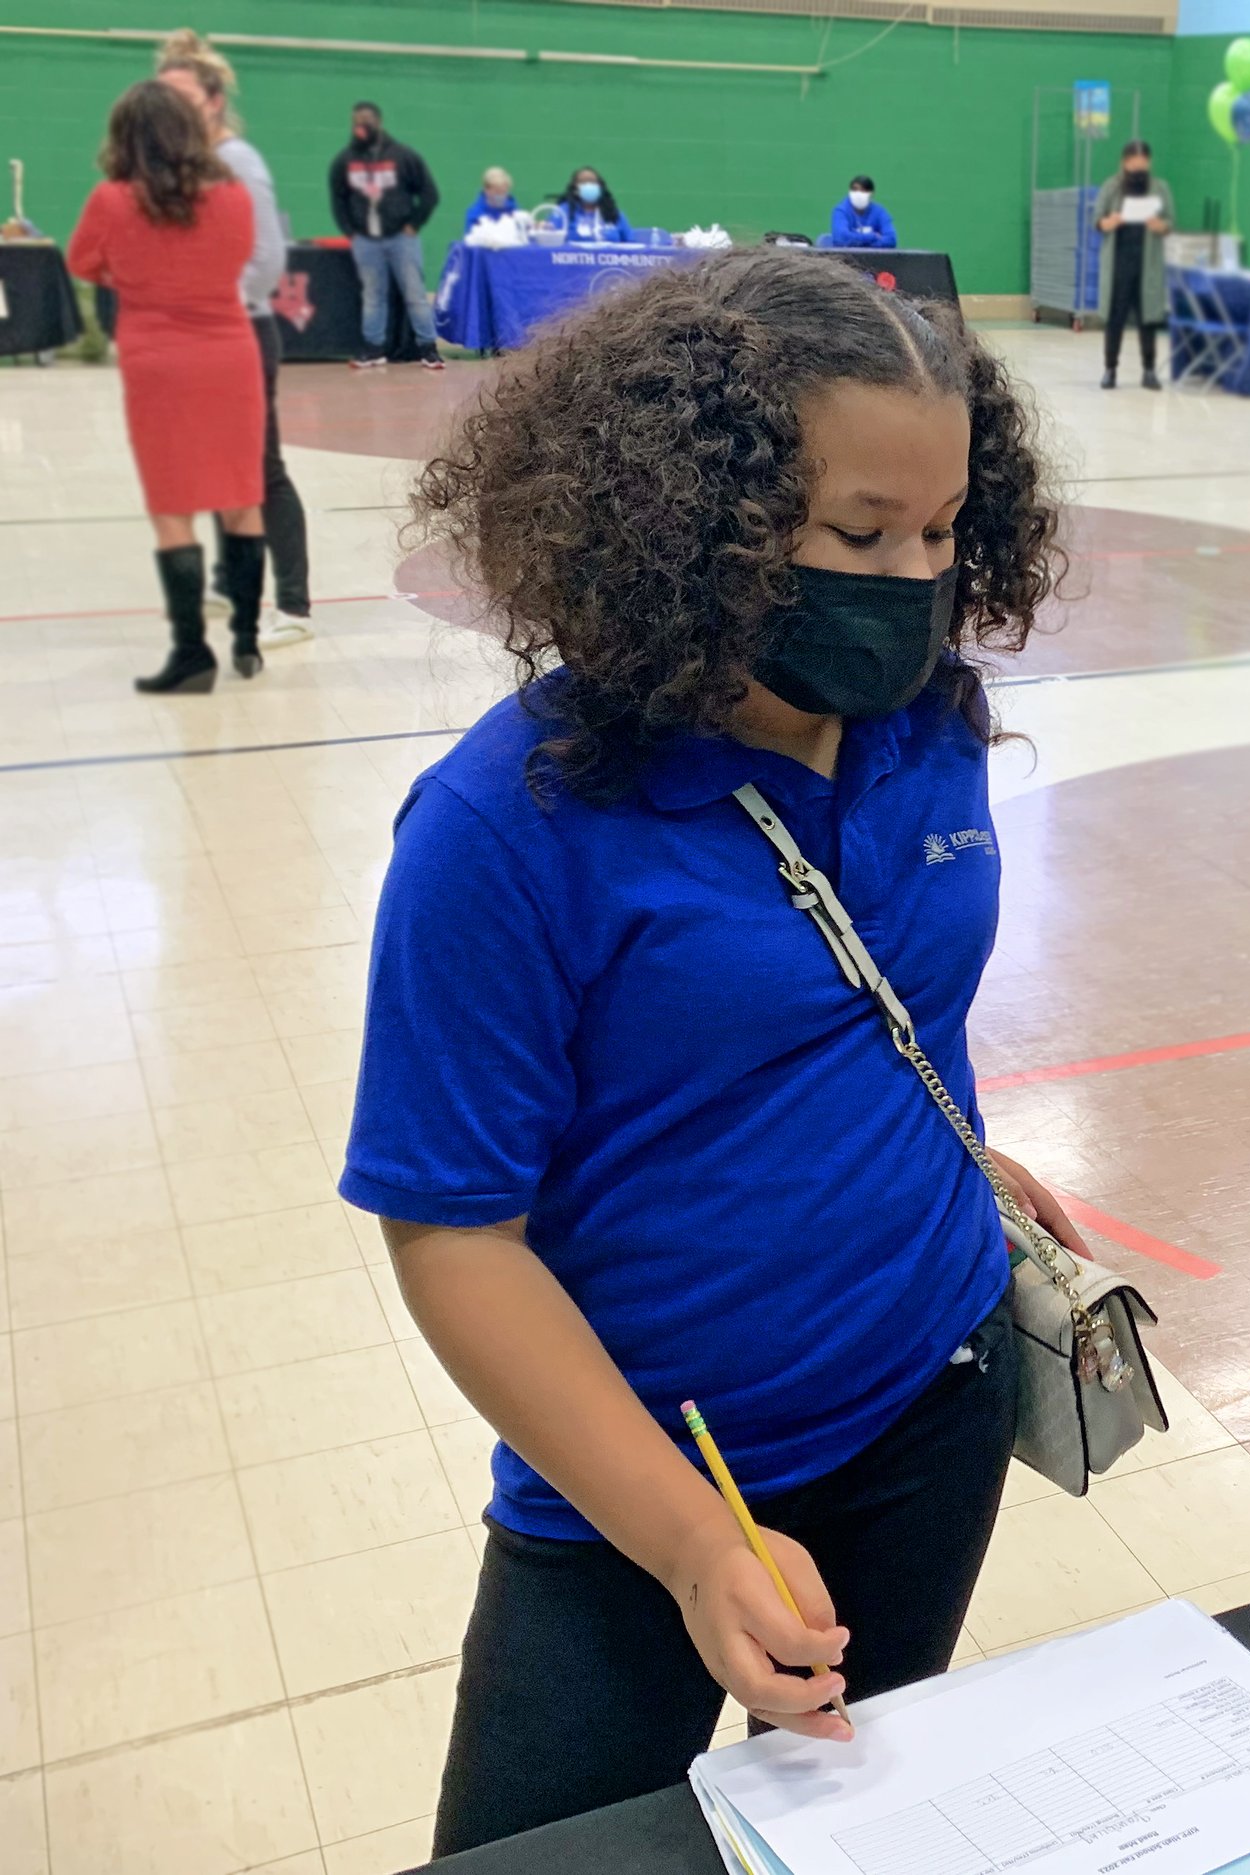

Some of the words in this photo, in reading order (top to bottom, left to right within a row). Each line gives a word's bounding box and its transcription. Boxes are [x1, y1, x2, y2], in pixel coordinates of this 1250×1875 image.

[551, 252, 595, 265] NORTH
[597, 252, 674, 266] COMMUNITY
[1137, 1831, 1159, 1843] Road
[1182, 1827, 1199, 1838] KIPP
[1118, 1840, 1138, 1850] Map
[1162, 1835, 1181, 1845] High
[1134, 1843, 1162, 1858] School
[1120, 1855, 1135, 1864] Fair
